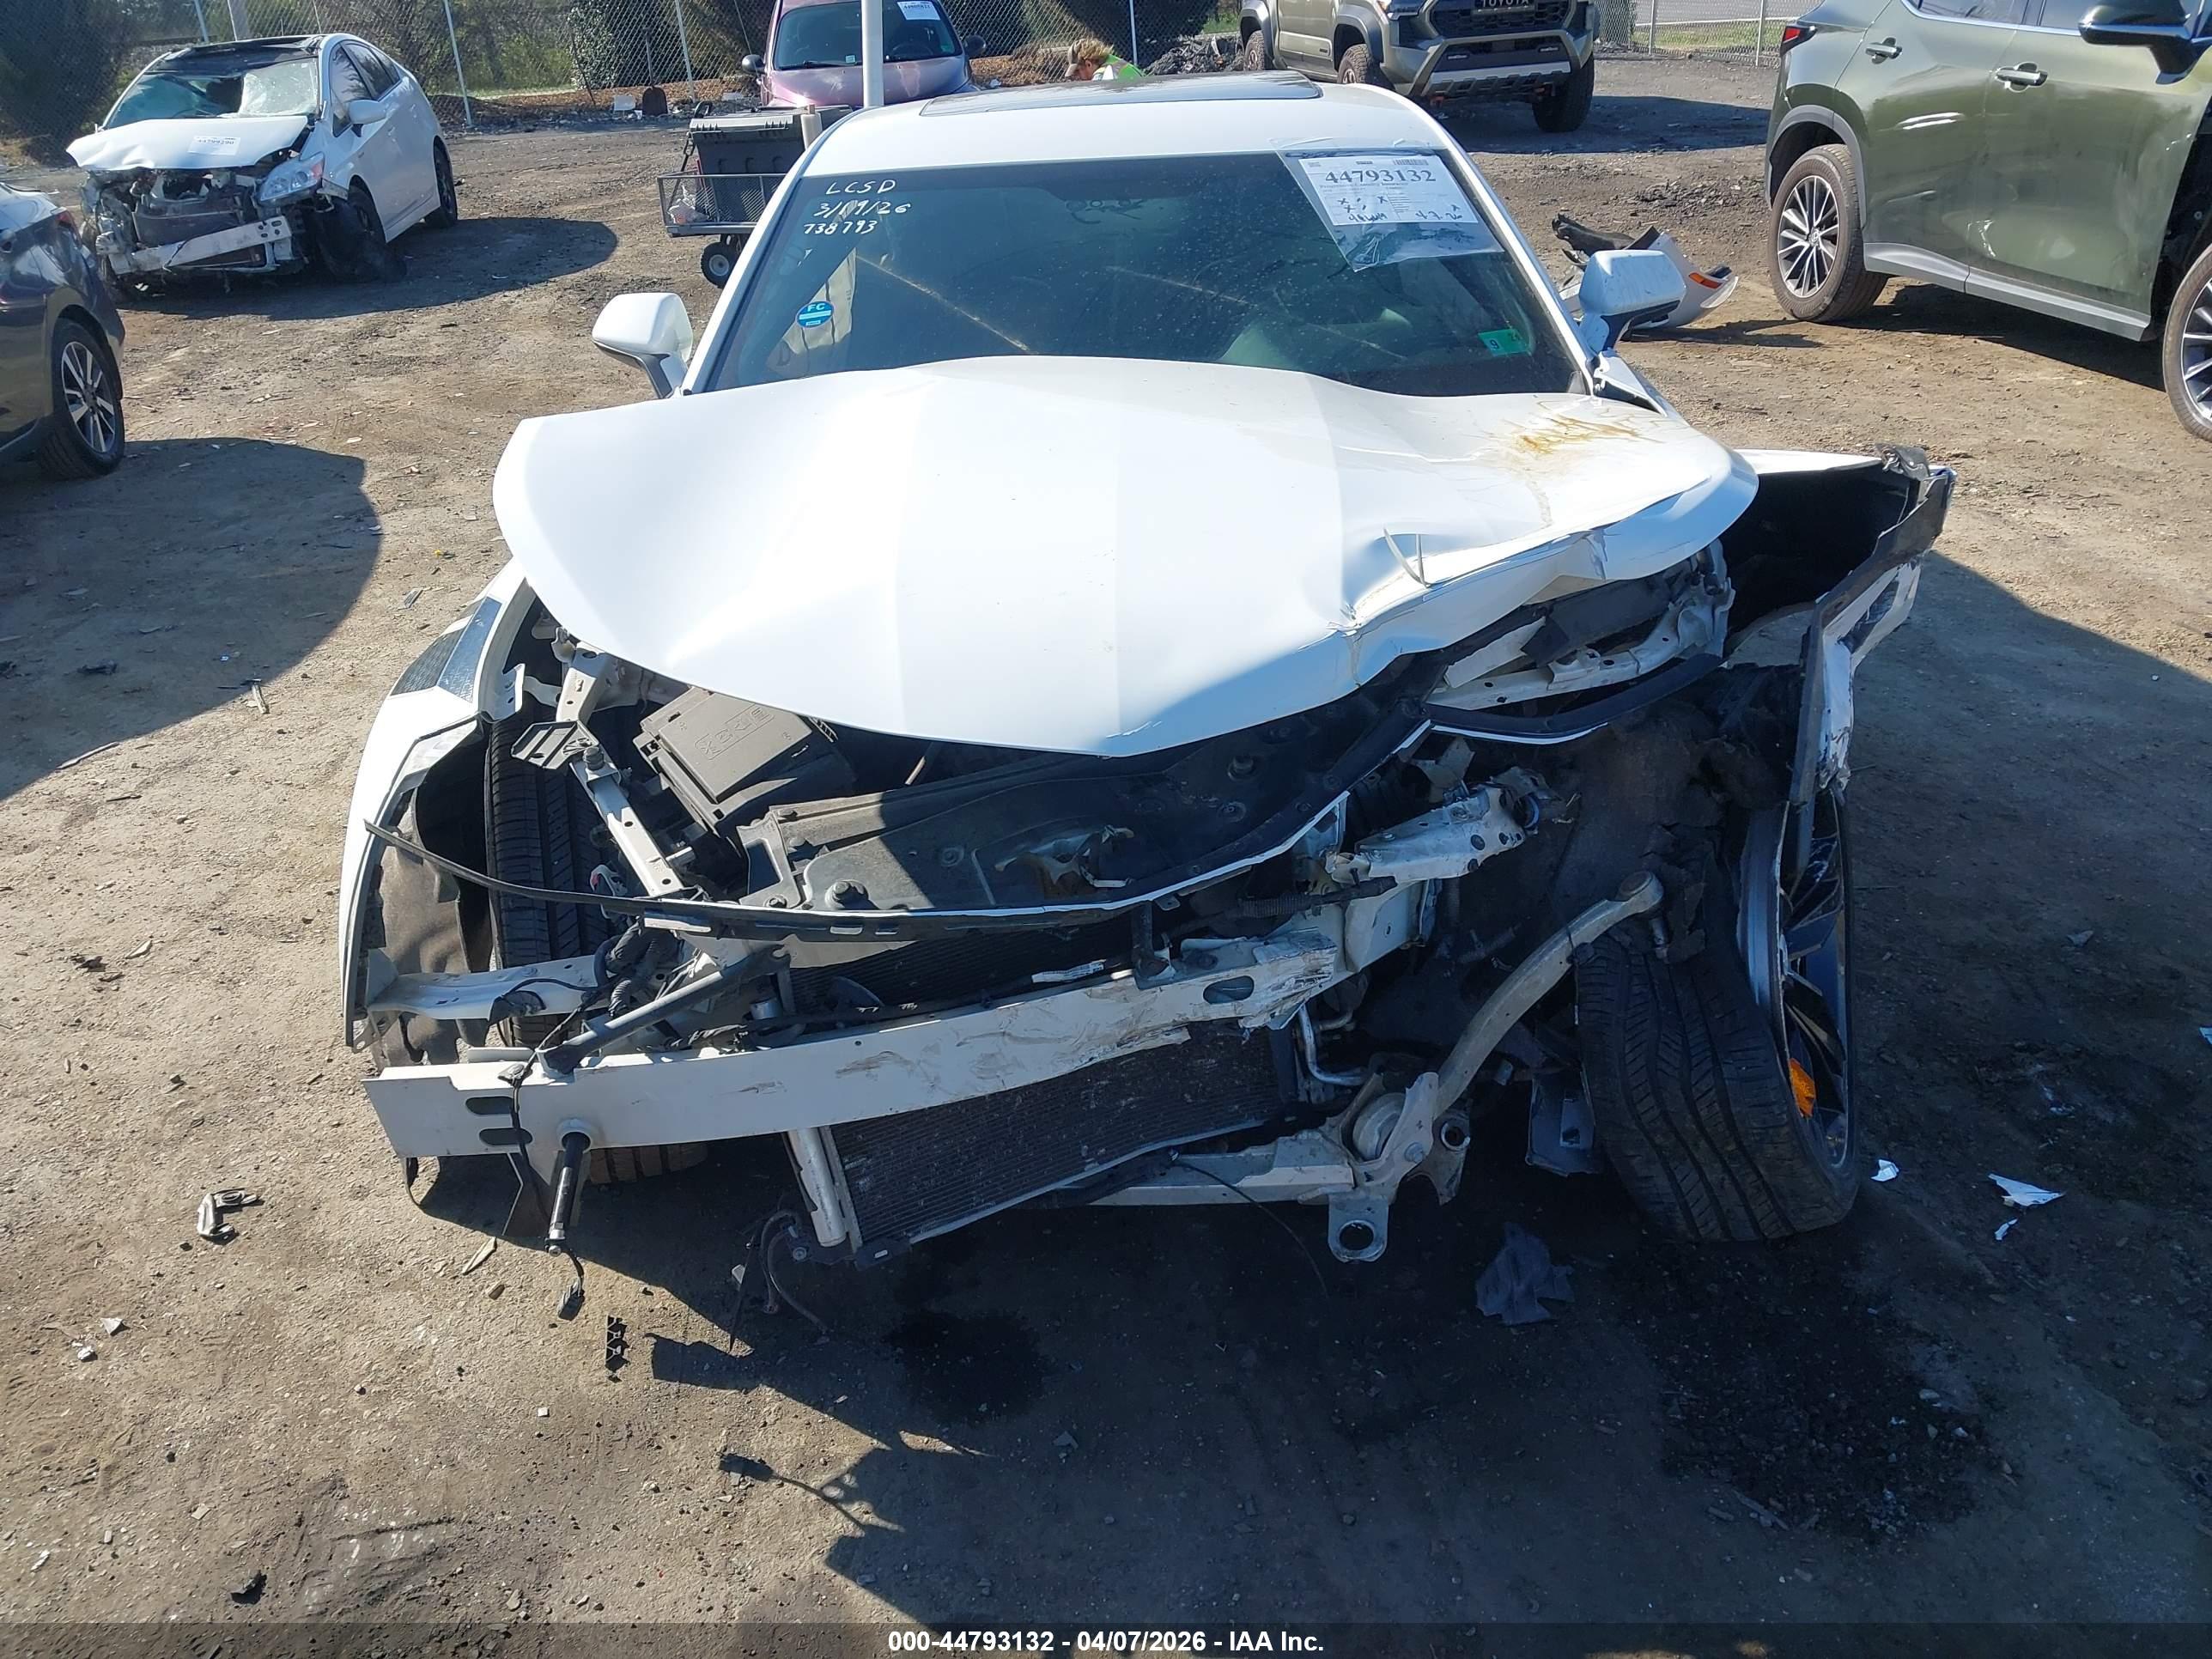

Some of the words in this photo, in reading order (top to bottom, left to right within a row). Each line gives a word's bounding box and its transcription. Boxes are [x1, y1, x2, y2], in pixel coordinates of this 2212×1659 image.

[1325, 169, 1437, 183] 44793132
[825, 179, 896, 195] LCSD
[1490, 339, 1499, 349] 9
